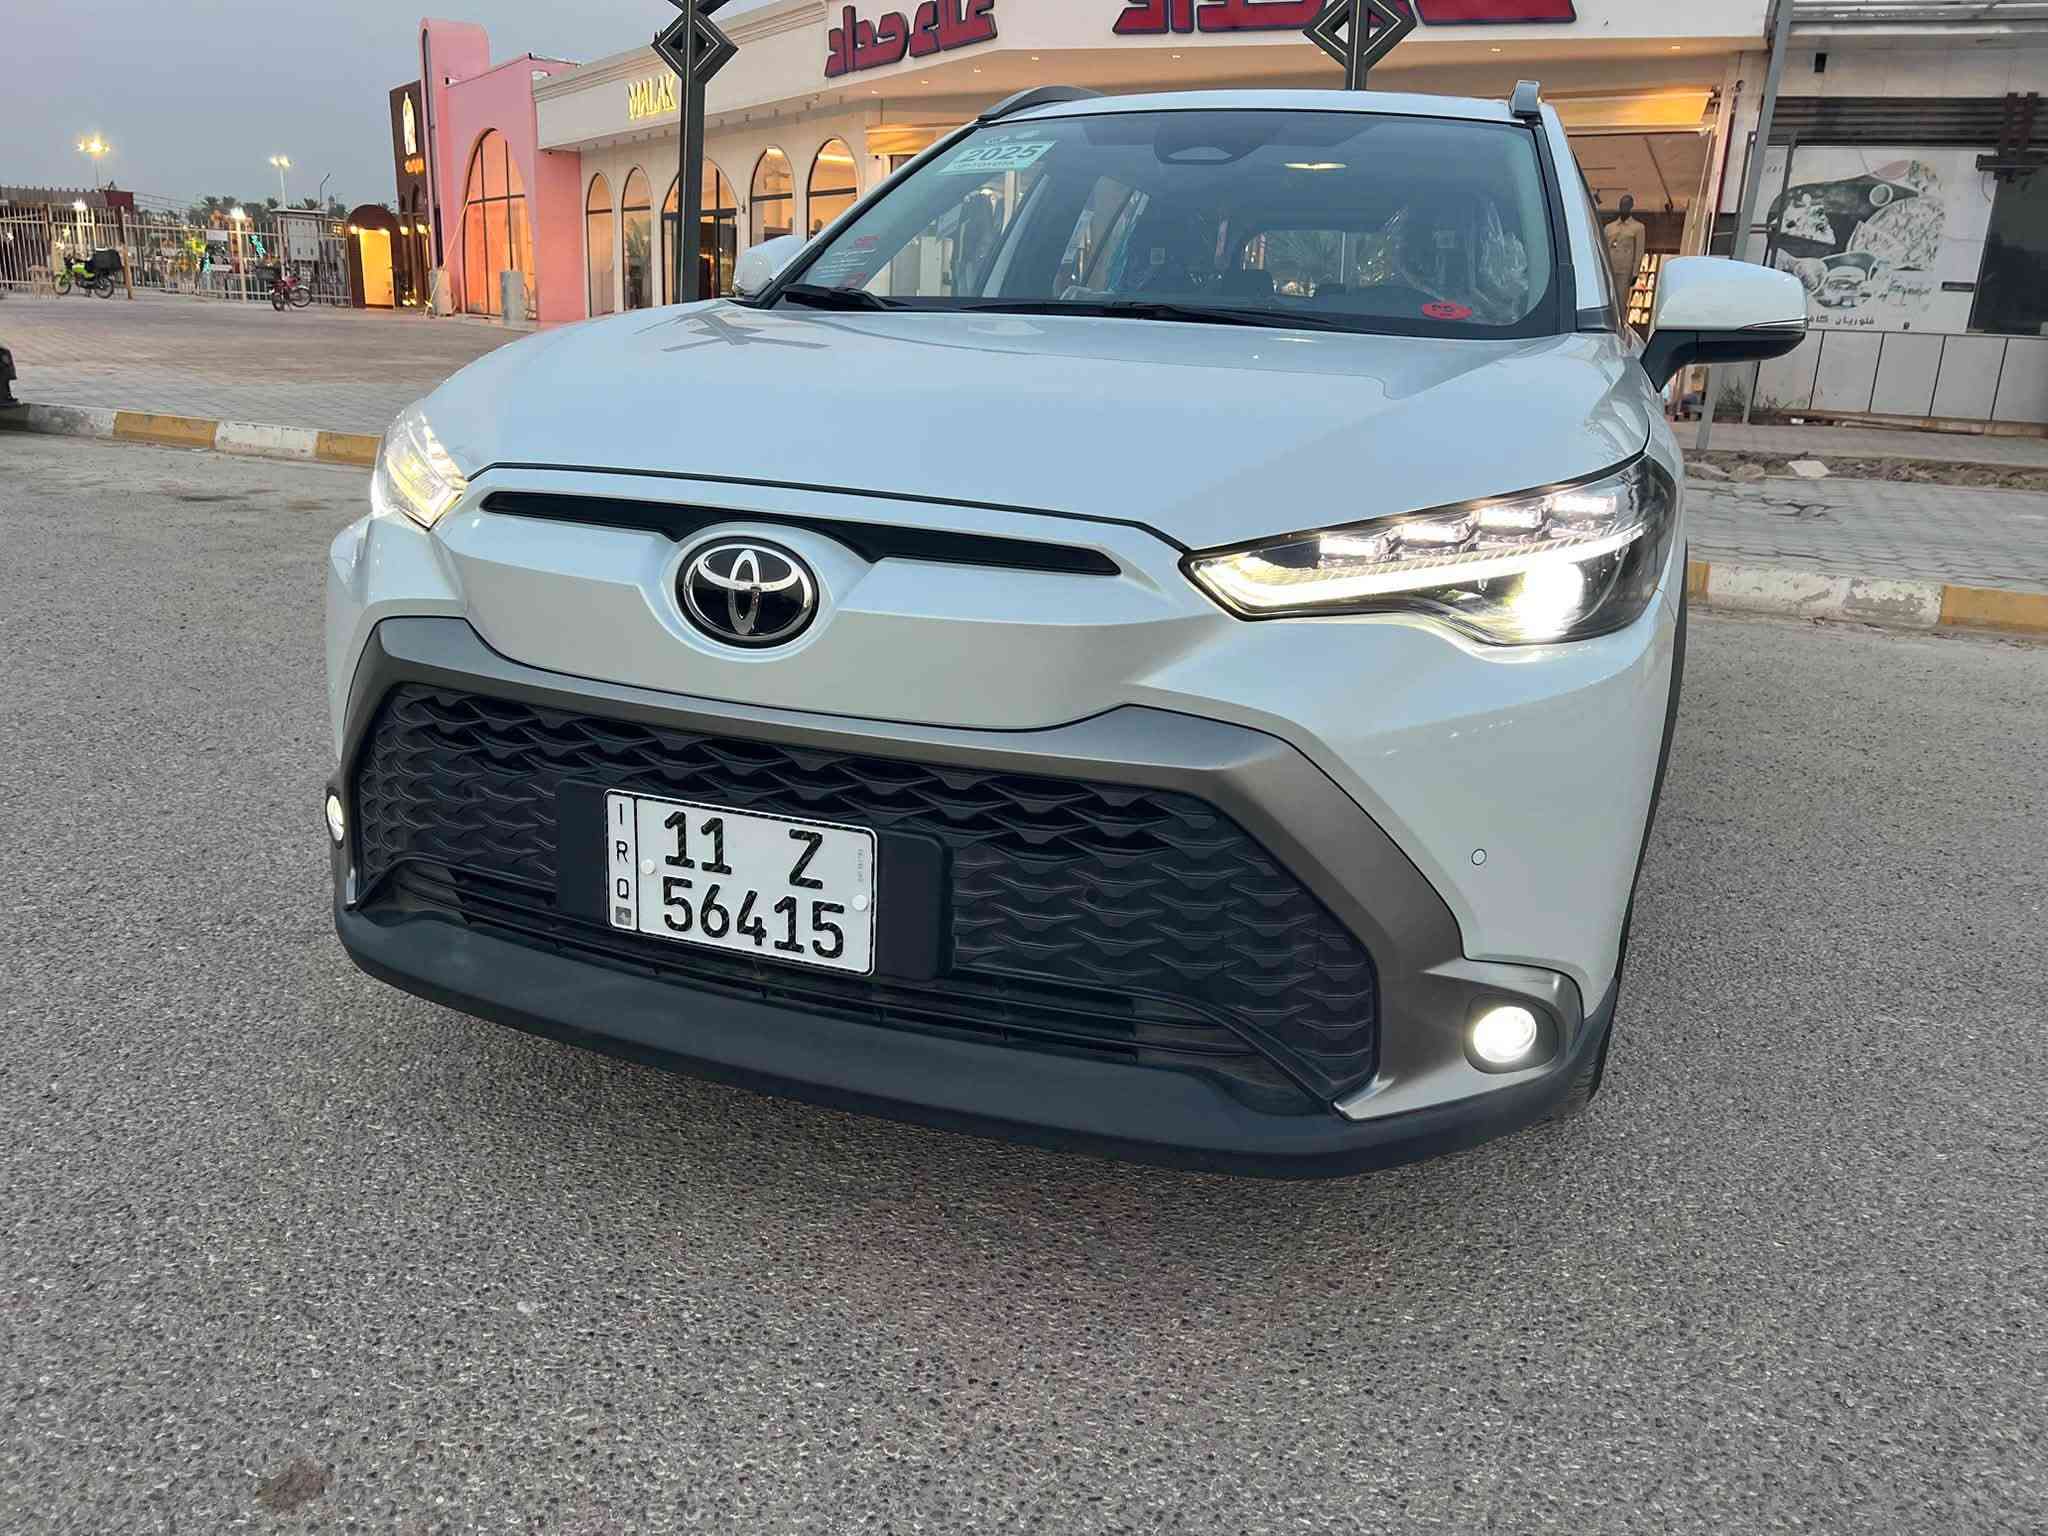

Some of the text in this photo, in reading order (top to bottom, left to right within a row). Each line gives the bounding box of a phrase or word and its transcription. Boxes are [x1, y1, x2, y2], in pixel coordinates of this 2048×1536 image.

[824, 5, 909, 77] حداد
[627, 73, 677, 120] MALAK
[961, 144, 1043, 161] 2025
[664, 811, 732, 875] 11
[789, 828, 824, 890] Z
[663, 875, 845, 959] 56415
